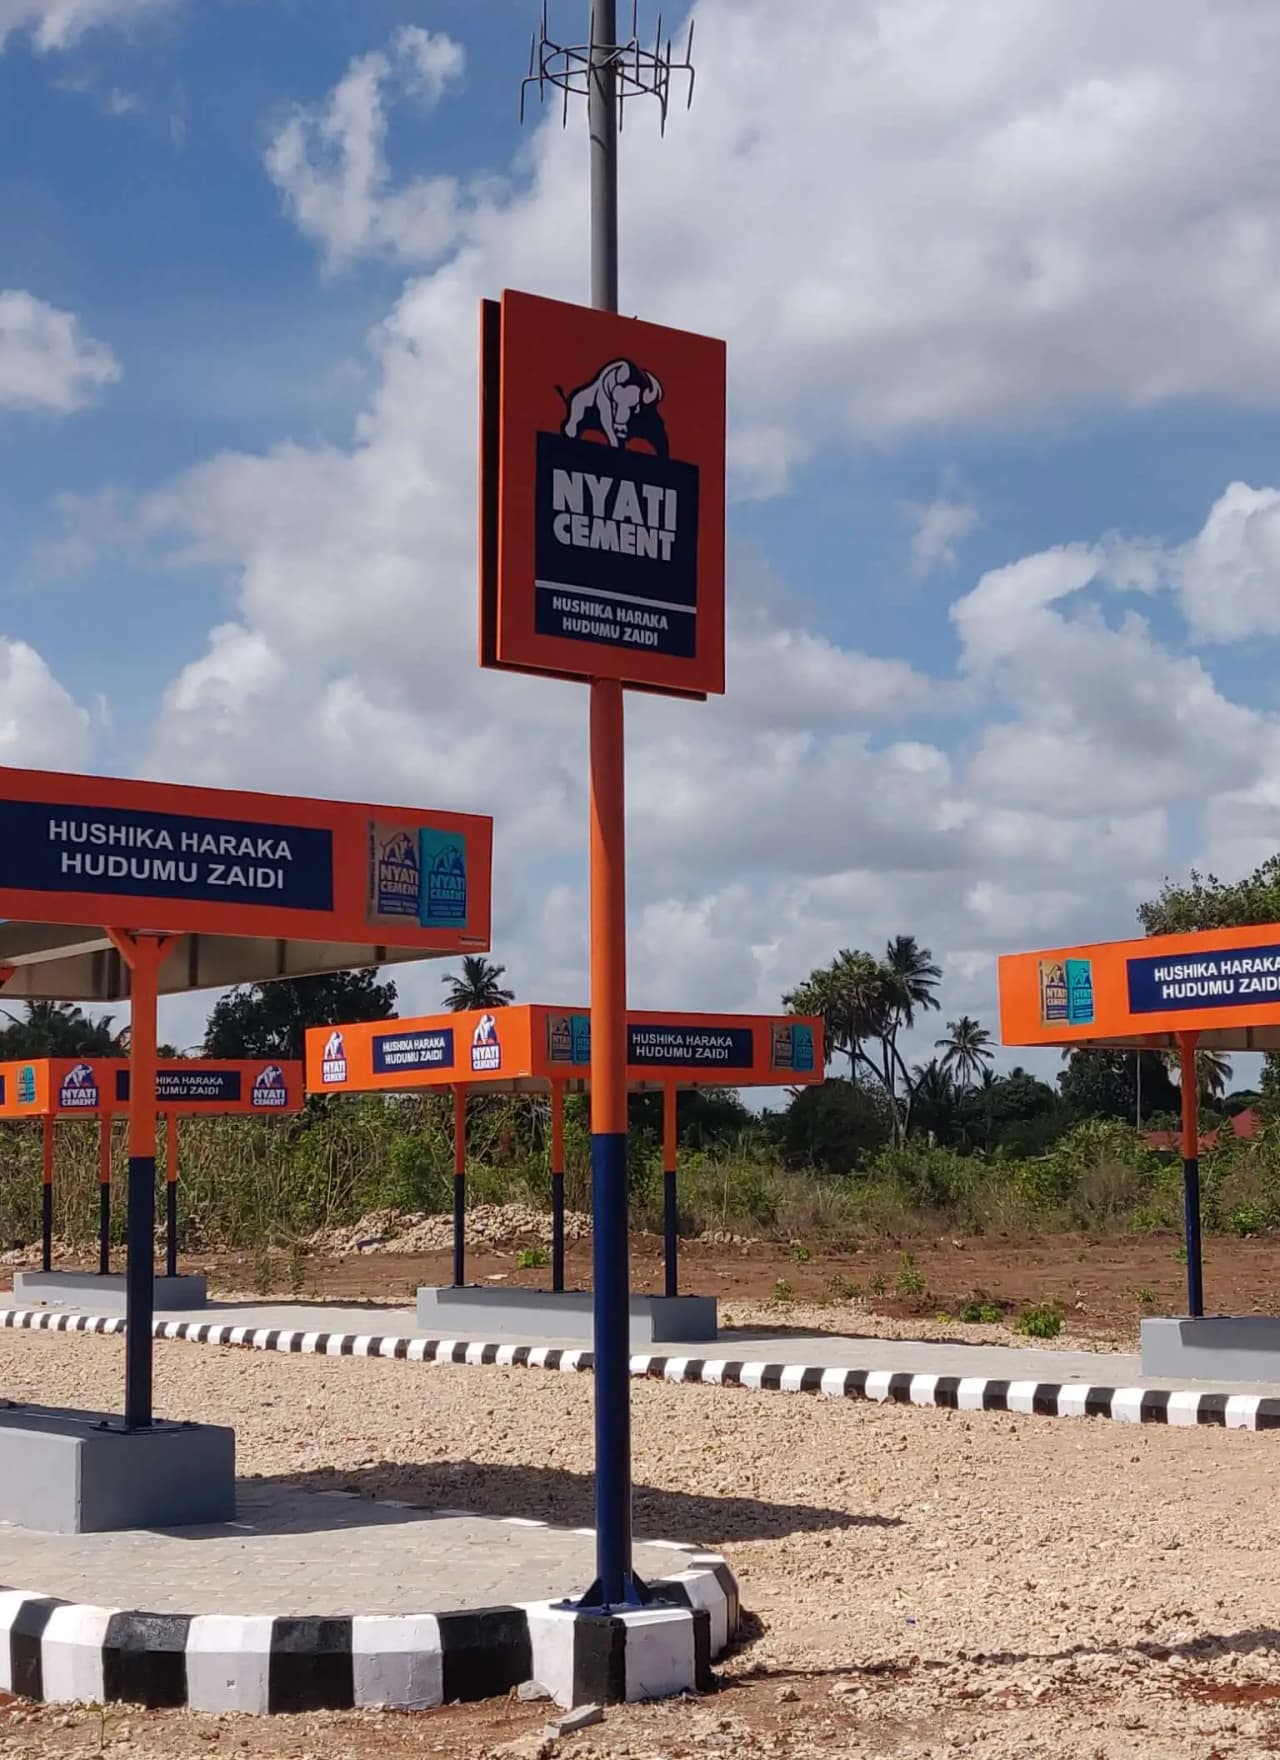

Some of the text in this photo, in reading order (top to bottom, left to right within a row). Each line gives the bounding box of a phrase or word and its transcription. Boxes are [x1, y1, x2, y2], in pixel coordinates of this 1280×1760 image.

[553, 468, 677, 531] NYATI
[553, 512, 675, 561] CEMENT
[552, 596, 669, 630] HUSHIKA HARAKA
[562, 617, 658, 646] HUDUMU ZAIDI
[48, 819, 293, 860] HUSHIKA HARAKA
[61, 852, 284, 889] HUDUMU ZAIDI
[1154, 962, 1218, 982] HUSHIKA
[1162, 979, 1234, 999] HUDUMU
[383, 1037, 445, 1053] HUSHIKA HARAKA
[632, 1033, 733, 1047] HUSHIKA HARAKA
[385, 1050, 442, 1065] HUDUMU ZAIDI
[472, 1045, 499, 1061] NYATI
[636, 1046, 729, 1059] HUDUMU ZAIDI
[156, 1076, 224, 1086] HIKA HARAKA
[61, 1088, 96, 1099] NYATI
[155, 1086, 220, 1095] DUMU ZAIDI
[253, 1089, 285, 1099] NYATI
[61, 1098, 96, 1106] CEMENT
[253, 1097, 285, 1106] CEMENT
